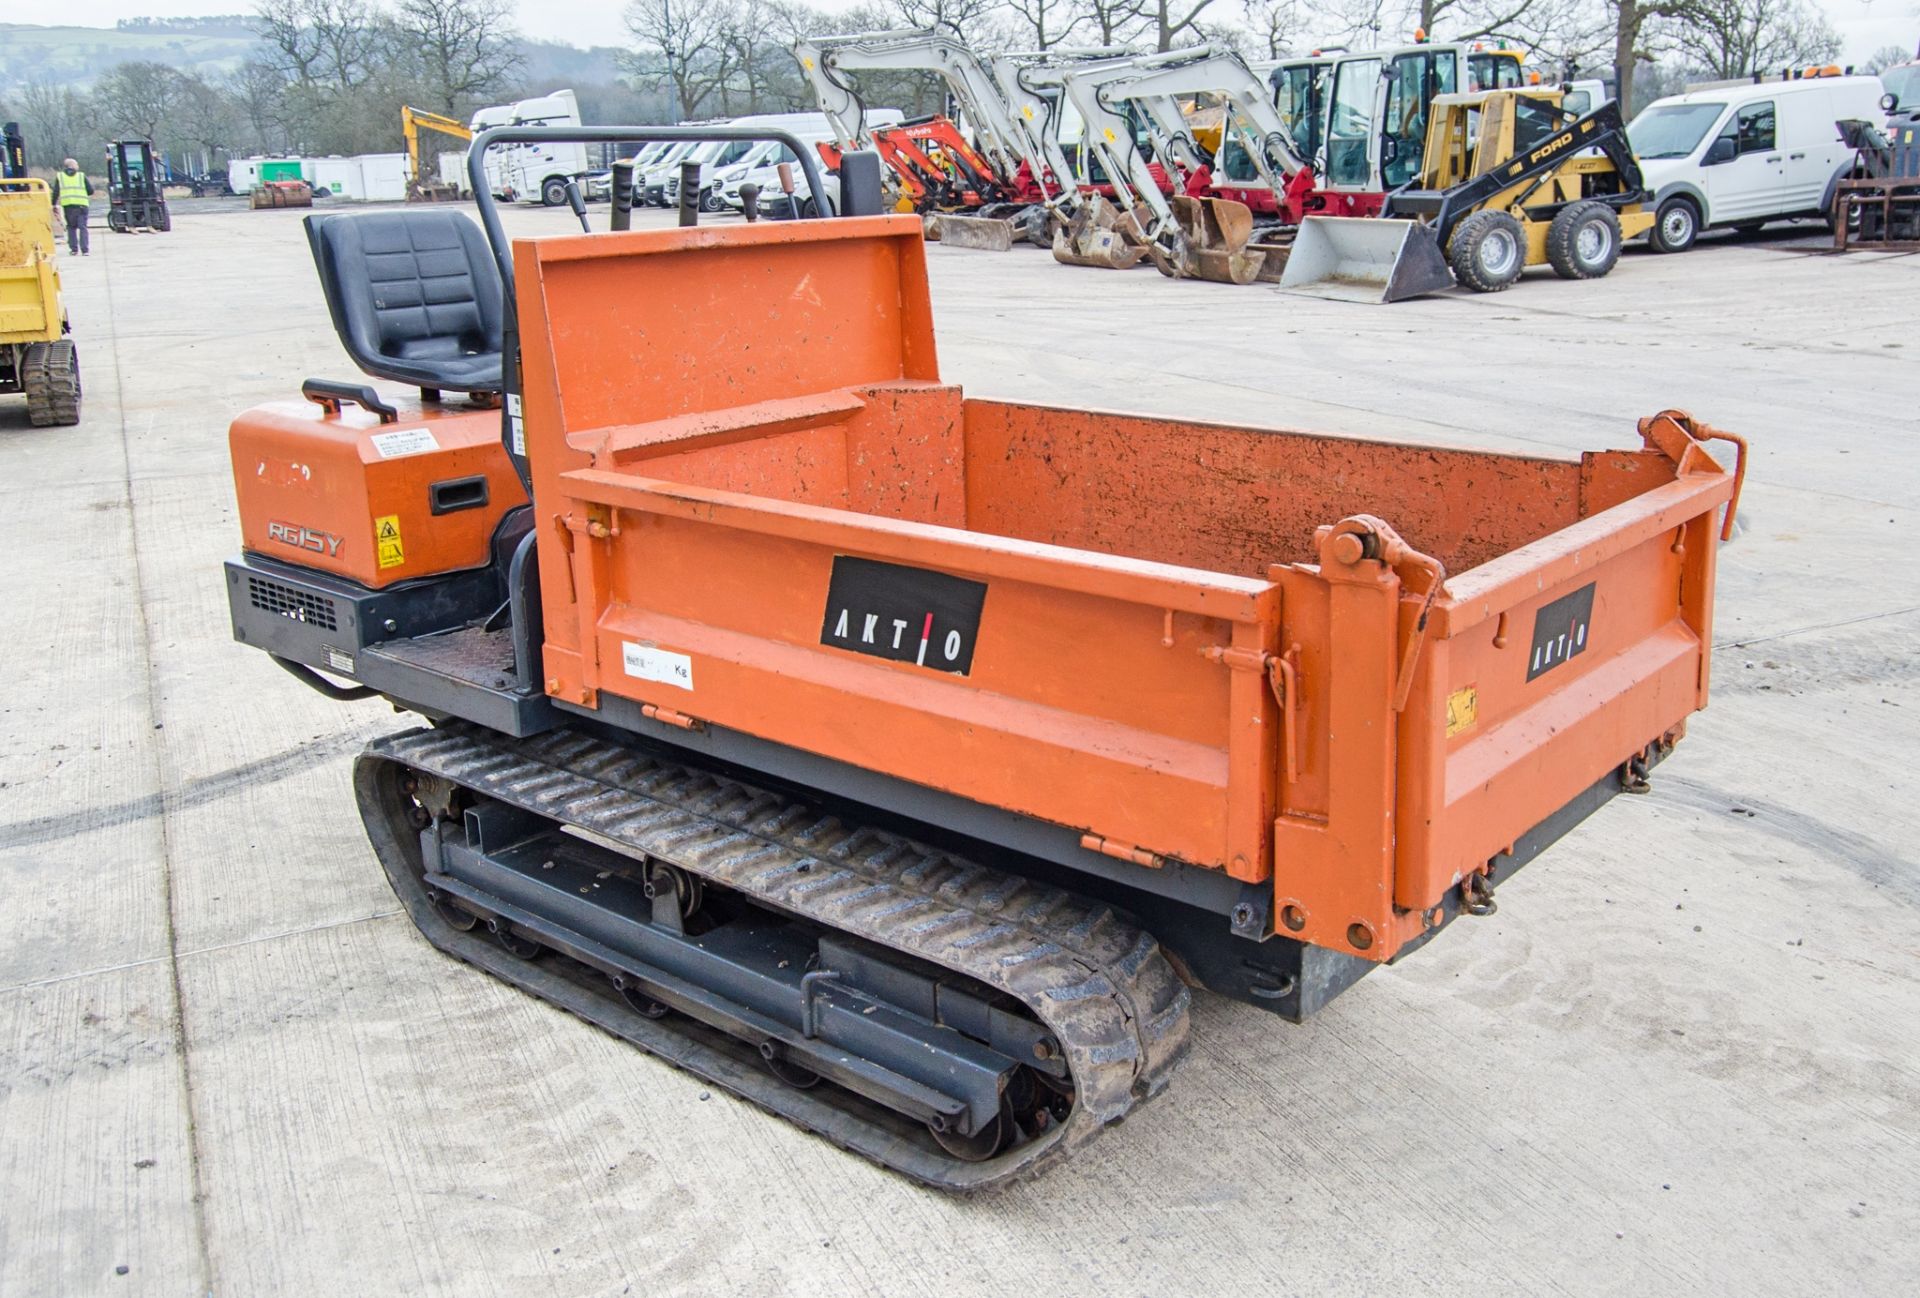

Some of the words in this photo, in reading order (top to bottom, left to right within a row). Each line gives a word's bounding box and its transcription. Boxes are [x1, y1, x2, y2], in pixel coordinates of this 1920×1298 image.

[1530, 132, 1573, 164] FORD
[834, 608, 961, 667] AKTIO
[1532, 617, 1585, 672] AKTIO
